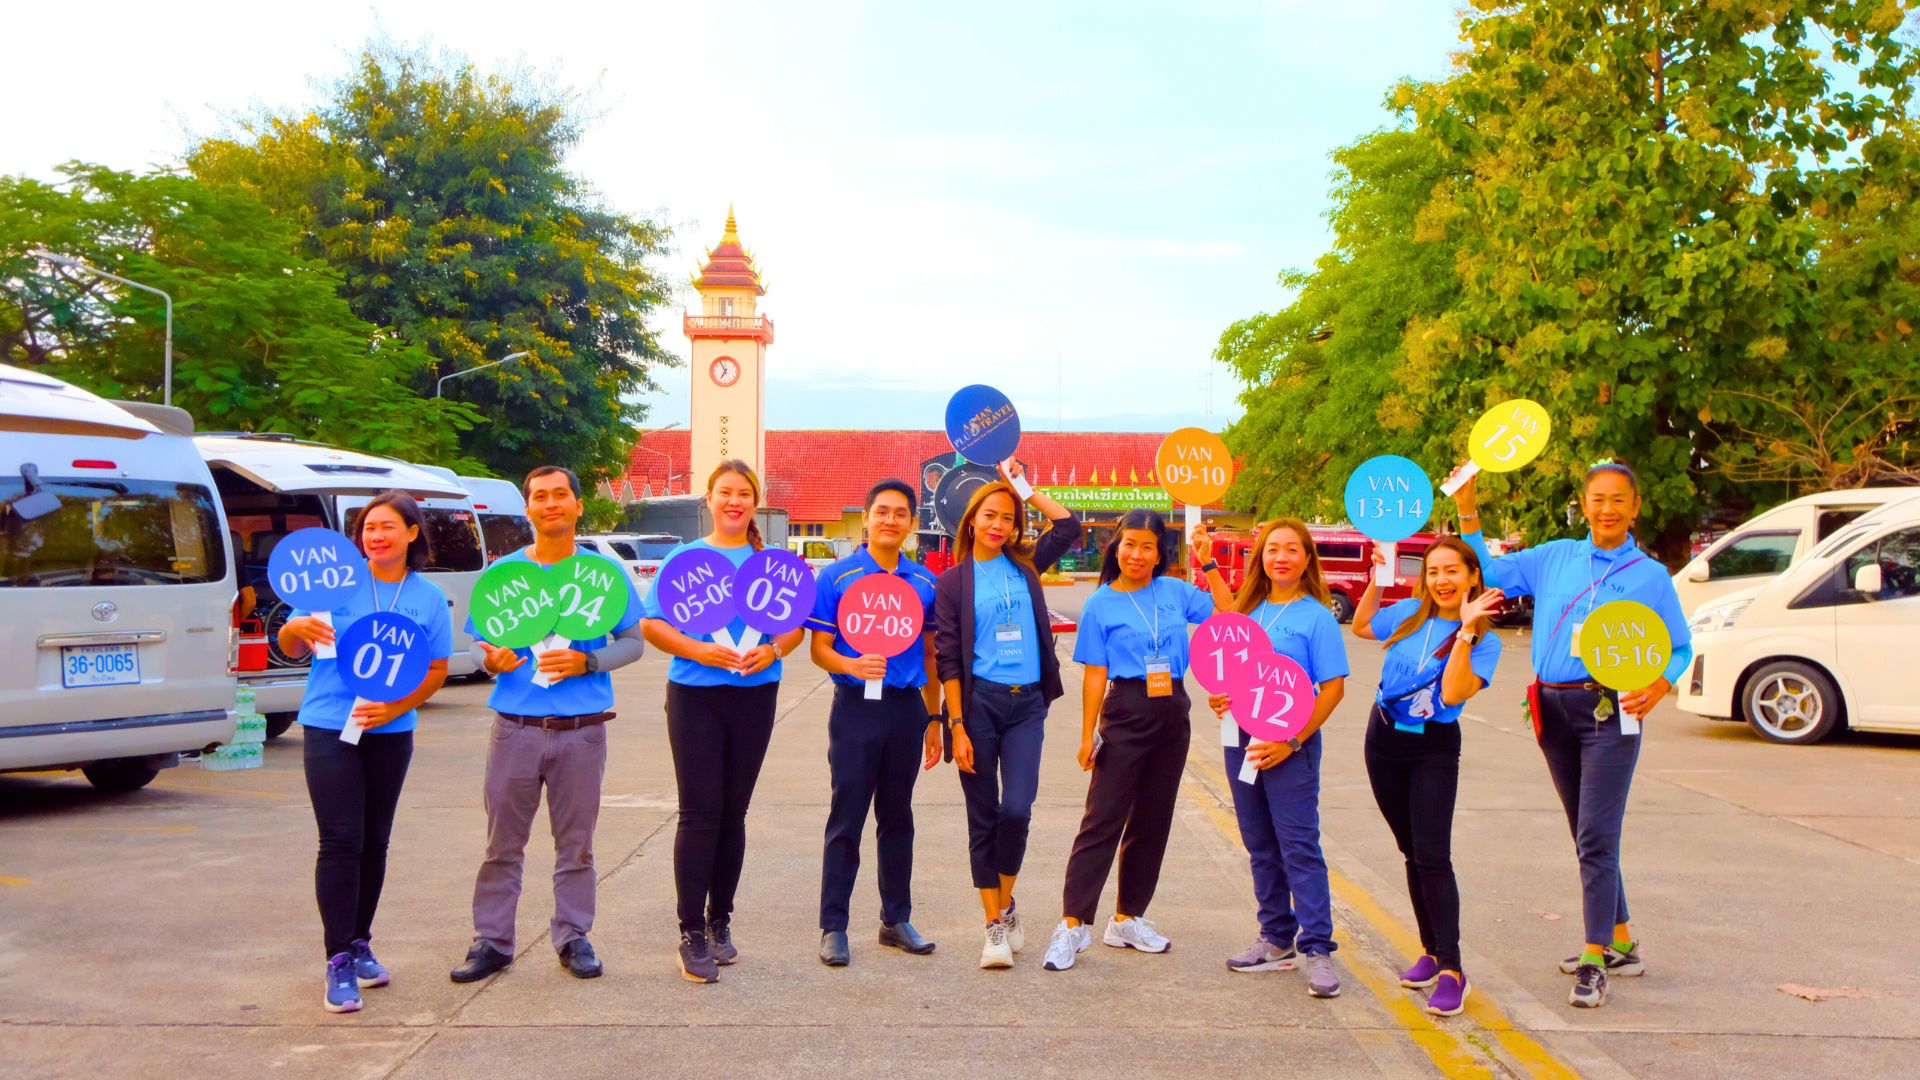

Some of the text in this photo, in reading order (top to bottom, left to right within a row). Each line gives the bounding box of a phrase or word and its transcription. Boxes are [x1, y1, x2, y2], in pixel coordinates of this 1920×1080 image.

[1510, 406, 1539, 436] VAN
[1176, 444, 1212, 462] VAN
[1483, 423, 1528, 462] 15
[1166, 464, 1225, 486] 09-10
[1368, 475, 1411, 493] VAN
[1357, 497, 1423, 519] 13-14
[290, 545, 338, 566] VAN
[280, 565, 356, 594] 01-02
[574, 562, 614, 592] VAN
[671, 562, 714, 594] VAN
[765, 556, 803, 587] VAN
[485, 575, 530, 608] VAN
[559, 583, 605, 627] 04
[673, 575, 732, 623] 05-06
[746, 577, 798, 621] 05
[861, 592, 902, 611] VAN
[486, 588, 554, 638] 03-04
[846, 612, 913, 638] 07-08
[373, 620, 416, 649] VAN
[1209, 625, 1250, 642] VAN
[1601, 621, 1645, 639] VAN
[68, 653, 134, 674] 36-0065
[353, 642, 405, 687] 01
[1000, 648, 1022, 656] TANNY
[1592, 643, 1662, 667] 15-16
[1257, 662, 1297, 689] VAN
[1250, 685, 1294, 728] 12
